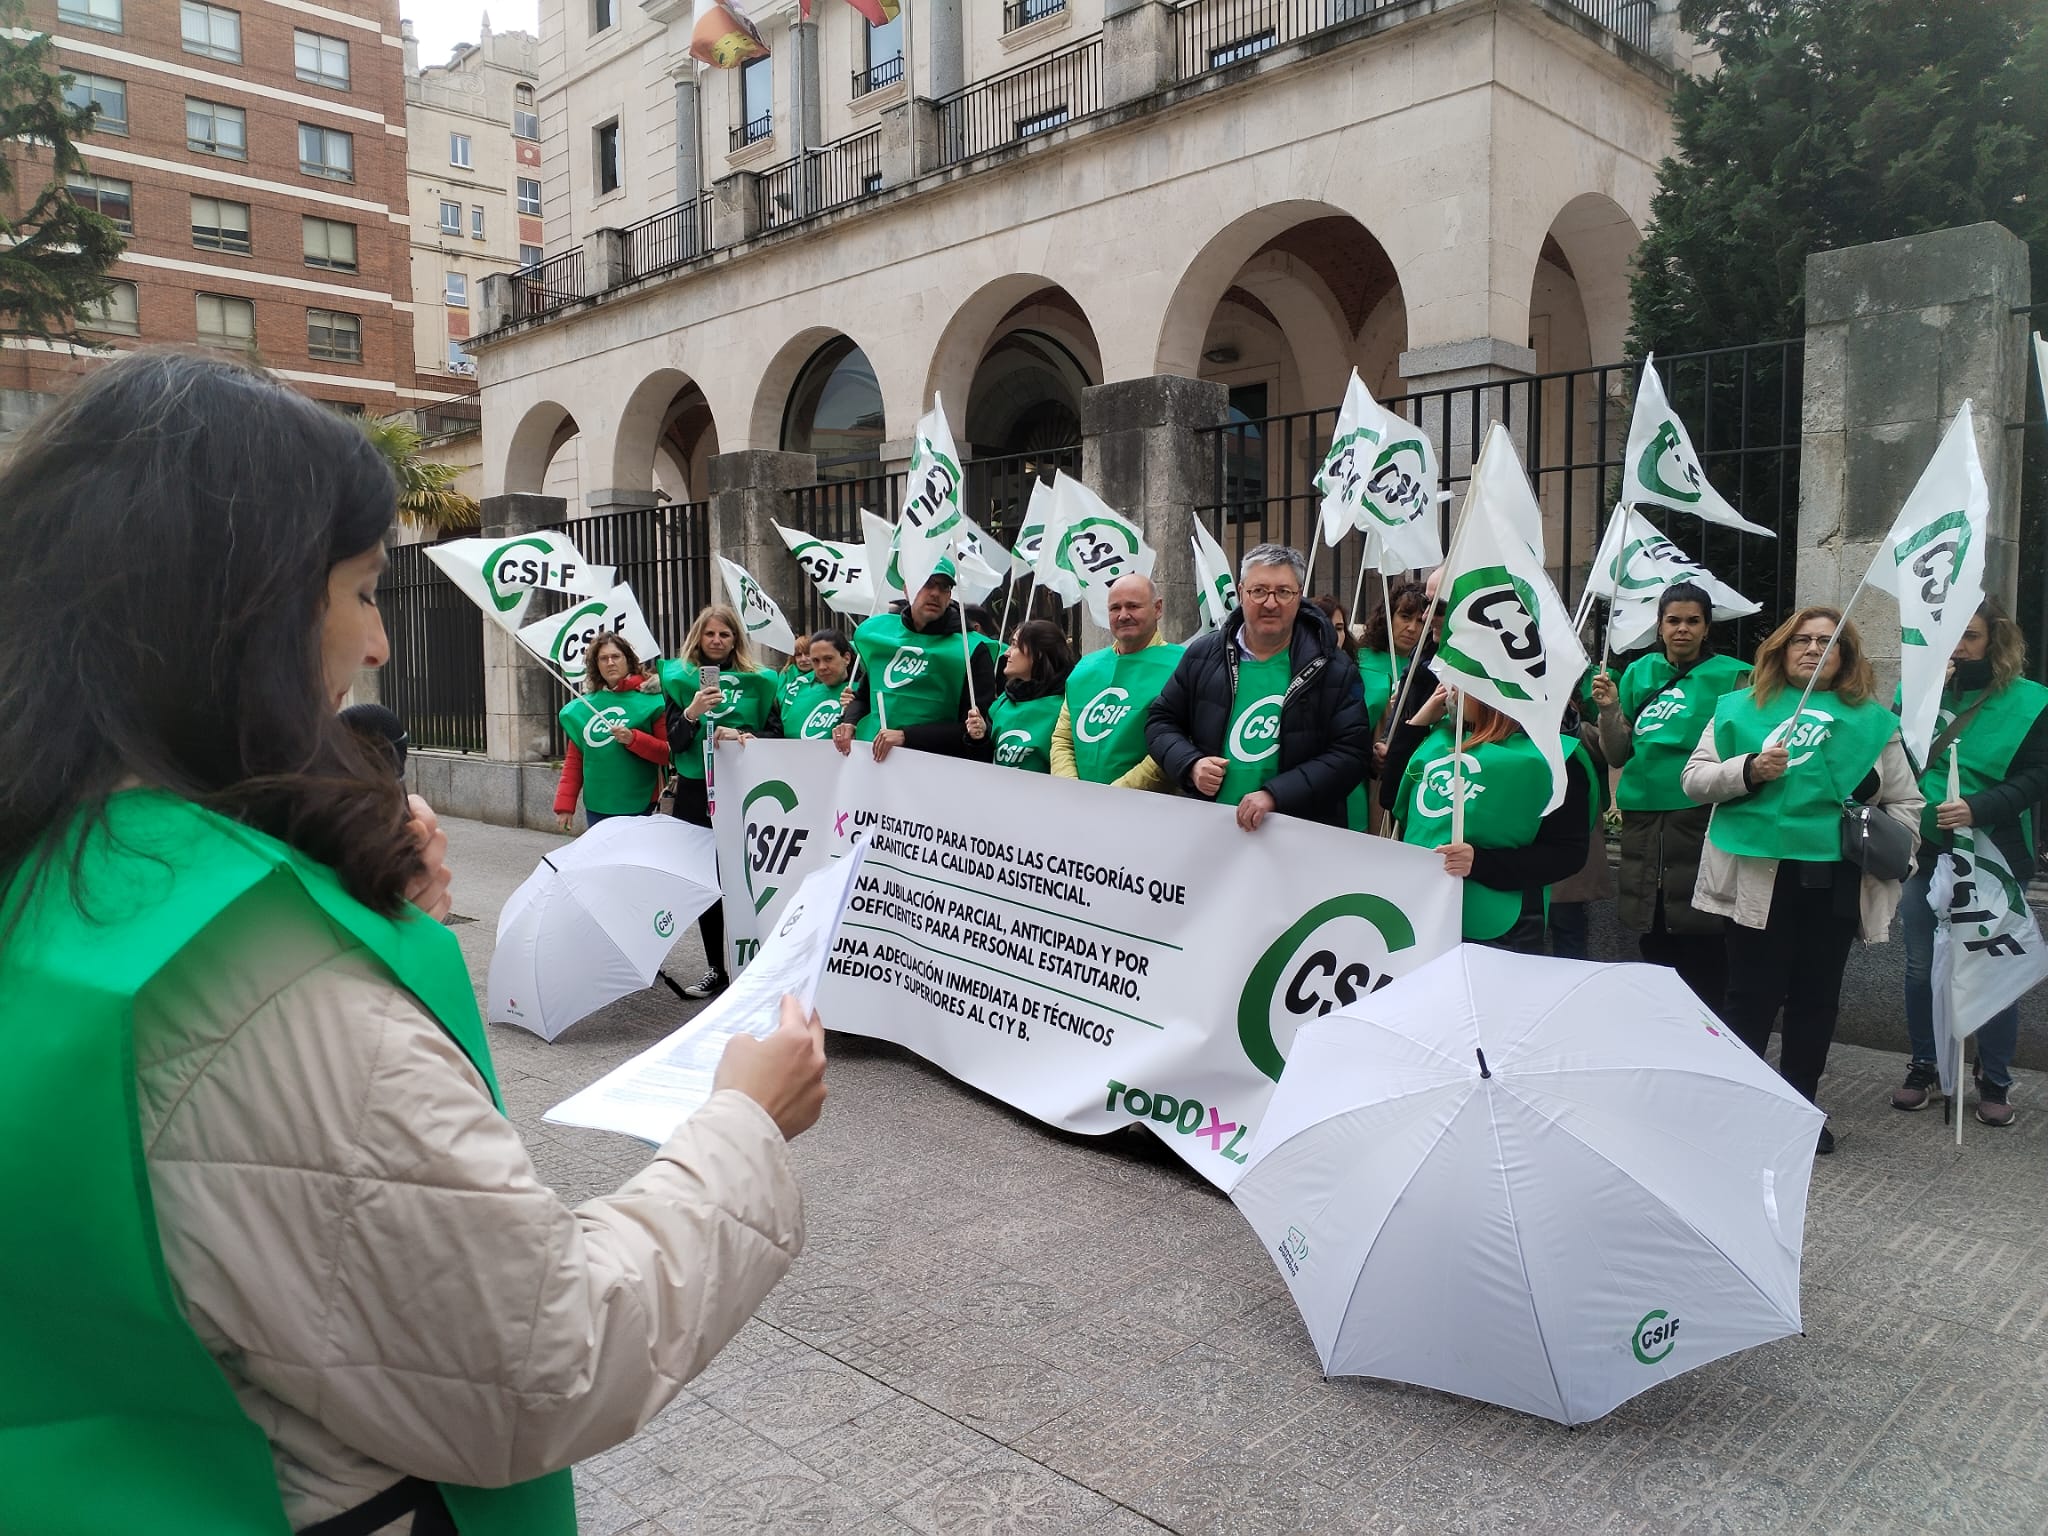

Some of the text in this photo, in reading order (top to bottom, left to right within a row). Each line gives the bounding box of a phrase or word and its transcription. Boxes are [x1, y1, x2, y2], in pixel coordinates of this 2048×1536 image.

[893, 656, 930, 676] CSIF
[718, 688, 744, 704] SIF
[808, 711, 840, 728] CSIF
[1088, 703, 1132, 724] CSIF
[996, 743, 1034, 763] CSIF
[854, 810, 879, 826] UN
[881, 814, 934, 842] ESTATUTO
[936, 828, 968, 851] PARA
[970, 836, 1014, 863] TODAS
[1017, 848, 1044, 870] LAS
[1047, 855, 1145, 896] CATEGORÍAS
[1148, 879, 1186, 905] QUE
[921, 847, 938, 866] LA
[941, 852, 995, 881] CALIDAD
[996, 867, 1091, 907] ASISTENCIAL.
[657, 910, 674, 931] CSIF
[854, 875, 1149, 977] NA JUBILACIÓN PARCIAL, ANTICIPADA Y POR
[847, 895, 923, 931] OEFICIENTES
[924, 916, 960, 943] PARA
[963, 928, 1035, 967] PERSONAL
[1038, 951, 1141, 1002] ESTATUTARIO.
[872, 944, 944, 986] ADECUACIÓN
[945, 971, 1018, 1013] INMEDIATA
[1021, 997, 1041, 1020] DE
[1043, 1003, 1115, 1047] TÉCNICOS
[894, 969, 903, 987] Y
[903, 974, 966, 1017] SUPERIORES
[966, 1003, 985, 1025] AL
[988, 1011, 1004, 1031] C1
[1005, 1015, 1017, 1035] Y
[1017, 1020, 1031, 1043] B.
[1641, 1318, 1681, 1350] CSIF
